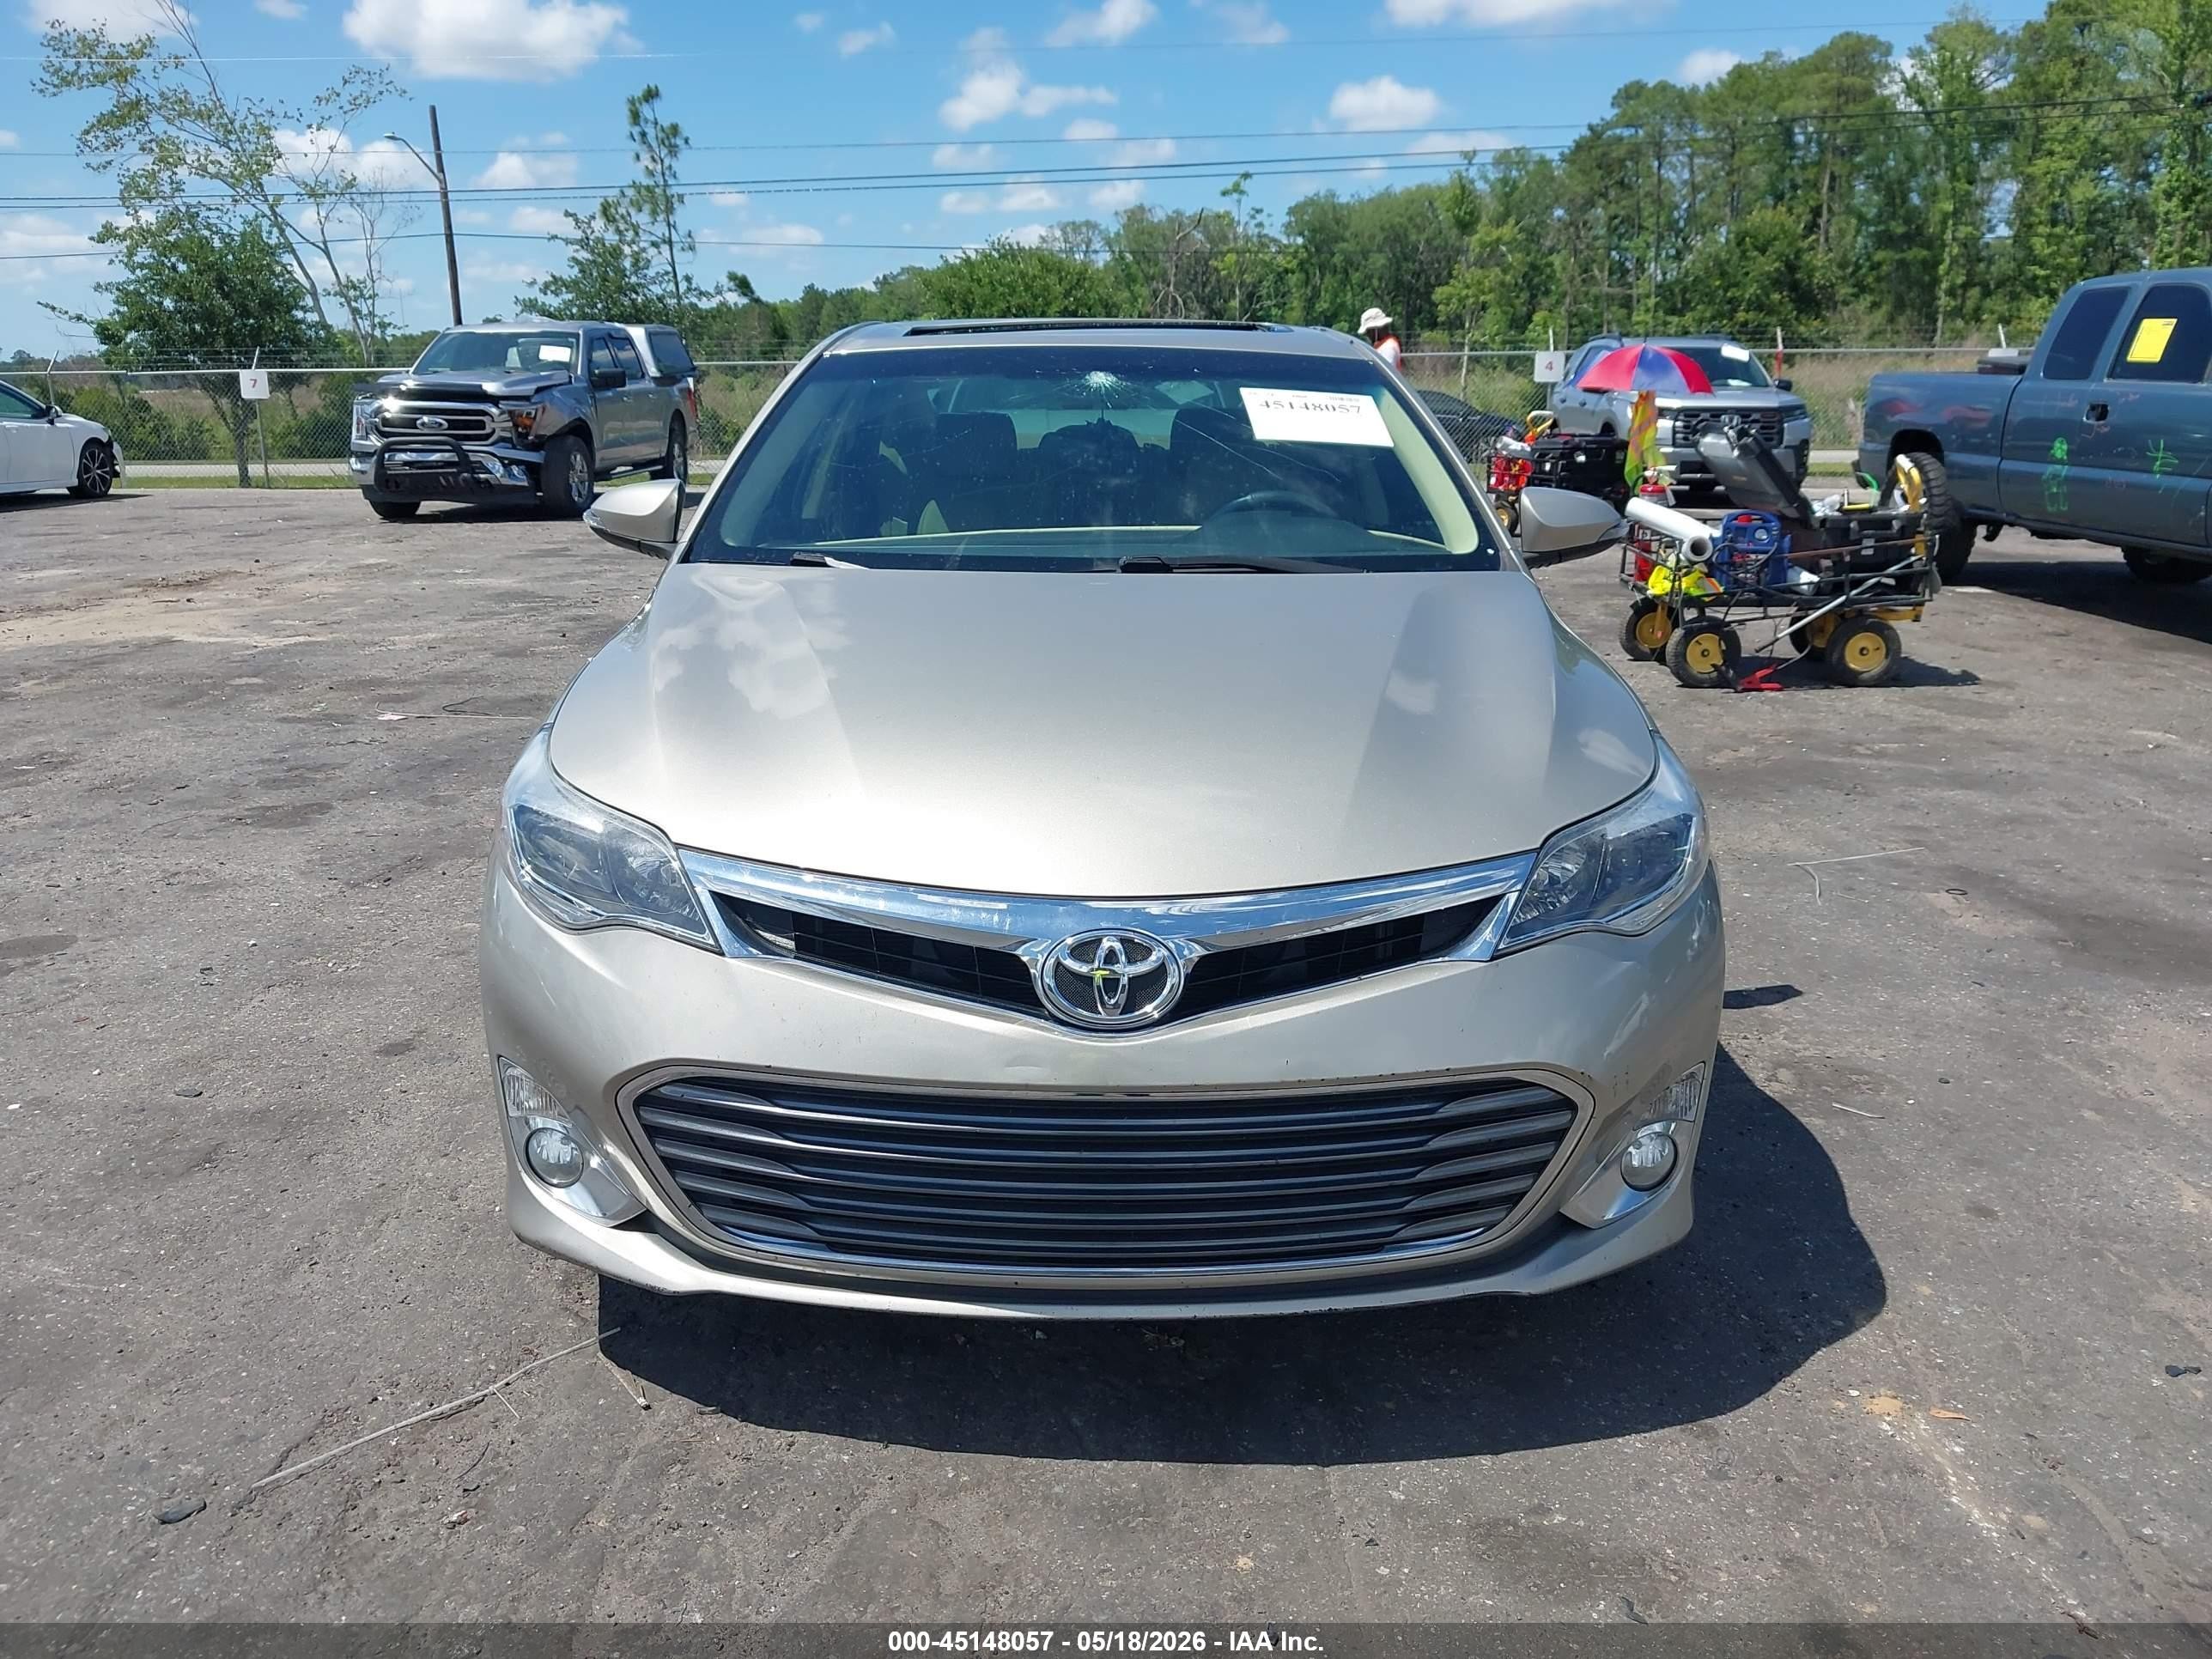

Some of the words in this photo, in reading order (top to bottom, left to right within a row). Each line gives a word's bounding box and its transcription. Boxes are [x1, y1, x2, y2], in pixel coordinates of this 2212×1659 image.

[1545, 361, 1553, 372] 4
[249, 378, 258, 388] 7
[1259, 400, 1361, 414] 45148057
